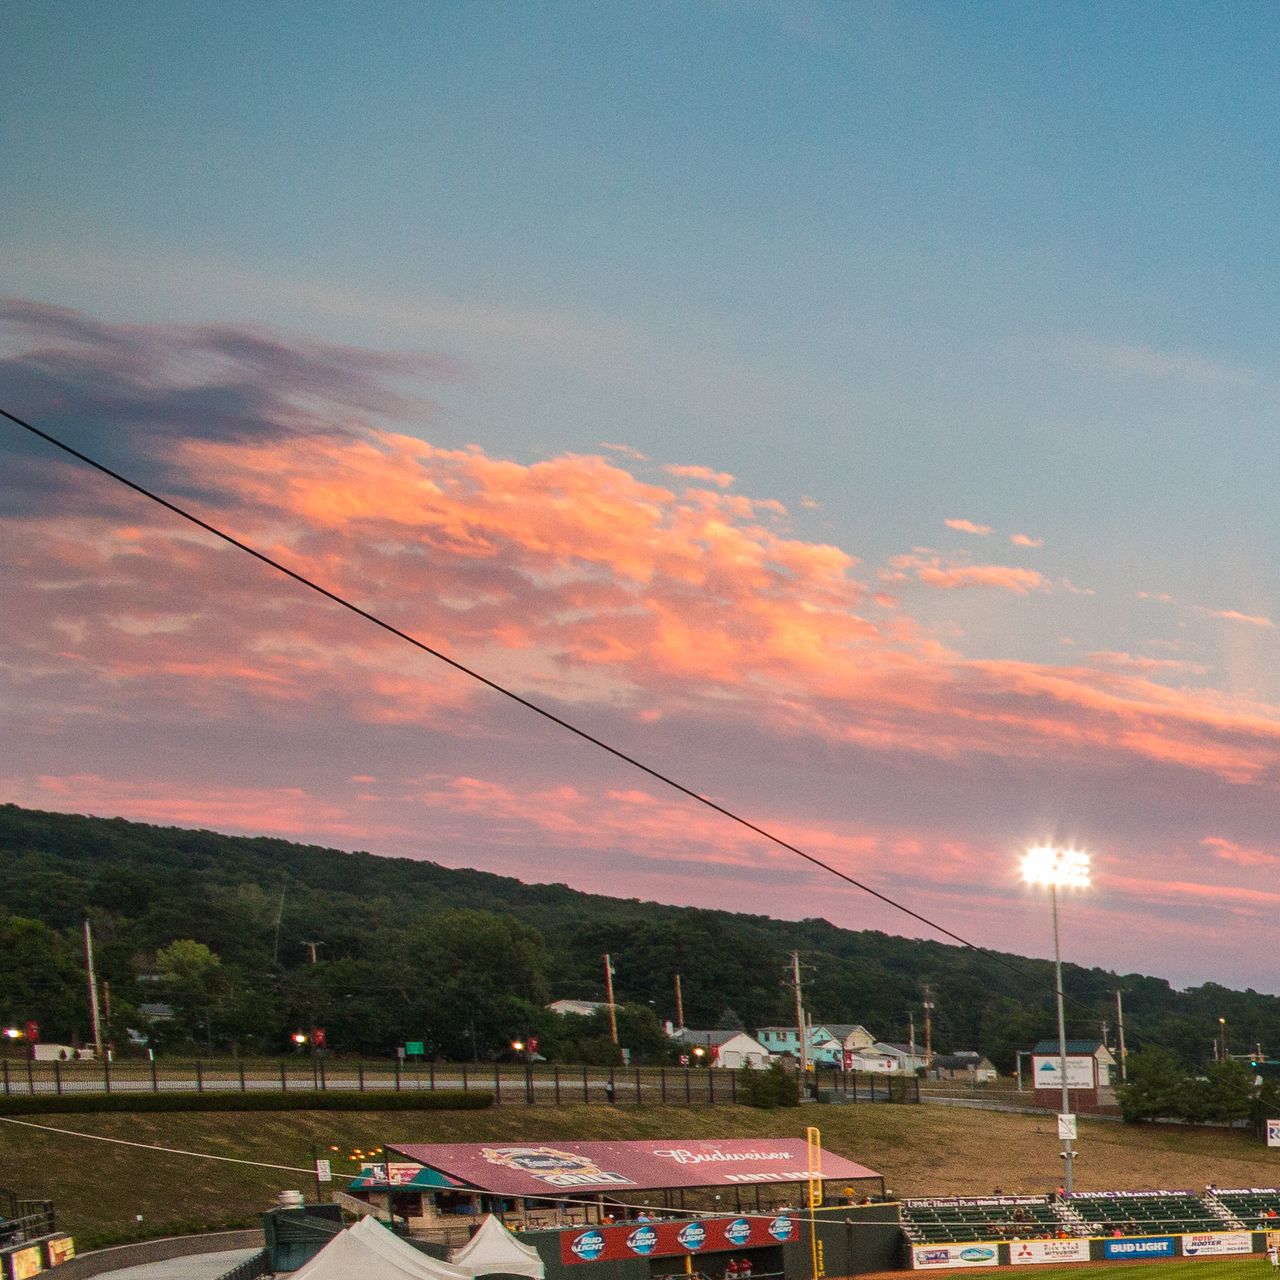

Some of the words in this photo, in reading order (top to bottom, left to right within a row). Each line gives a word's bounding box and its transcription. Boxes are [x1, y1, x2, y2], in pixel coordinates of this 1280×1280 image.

[653, 1148, 794, 1165] Budweiser
[724, 1172, 782, 1183] PARTY
[1072, 1191, 1114, 1199] UPMC
[1117, 1190, 1158, 1198] HEALTH
[1159, 1189, 1187, 1197] PLAN
[908, 1199, 932, 1208] UPMC
[960, 1199, 976, 1207] PLAN
[732, 1224, 750, 1232] BUD
[775, 1219, 792, 1228] BUD
[686, 1228, 704, 1237] BUD
[724, 1229, 751, 1239] LIGHT
[768, 1226, 793, 1236] LIGHT
[581, 1236, 602, 1245] BUD
[636, 1232, 655, 1241] BUD
[677, 1234, 706, 1244] LIGHT
[572, 1241, 606, 1253] LIGHT
[627, 1238, 657, 1248] LIGHT
[1110, 1243, 1135, 1253] BUD
[1134, 1241, 1169, 1252] LIGHT
